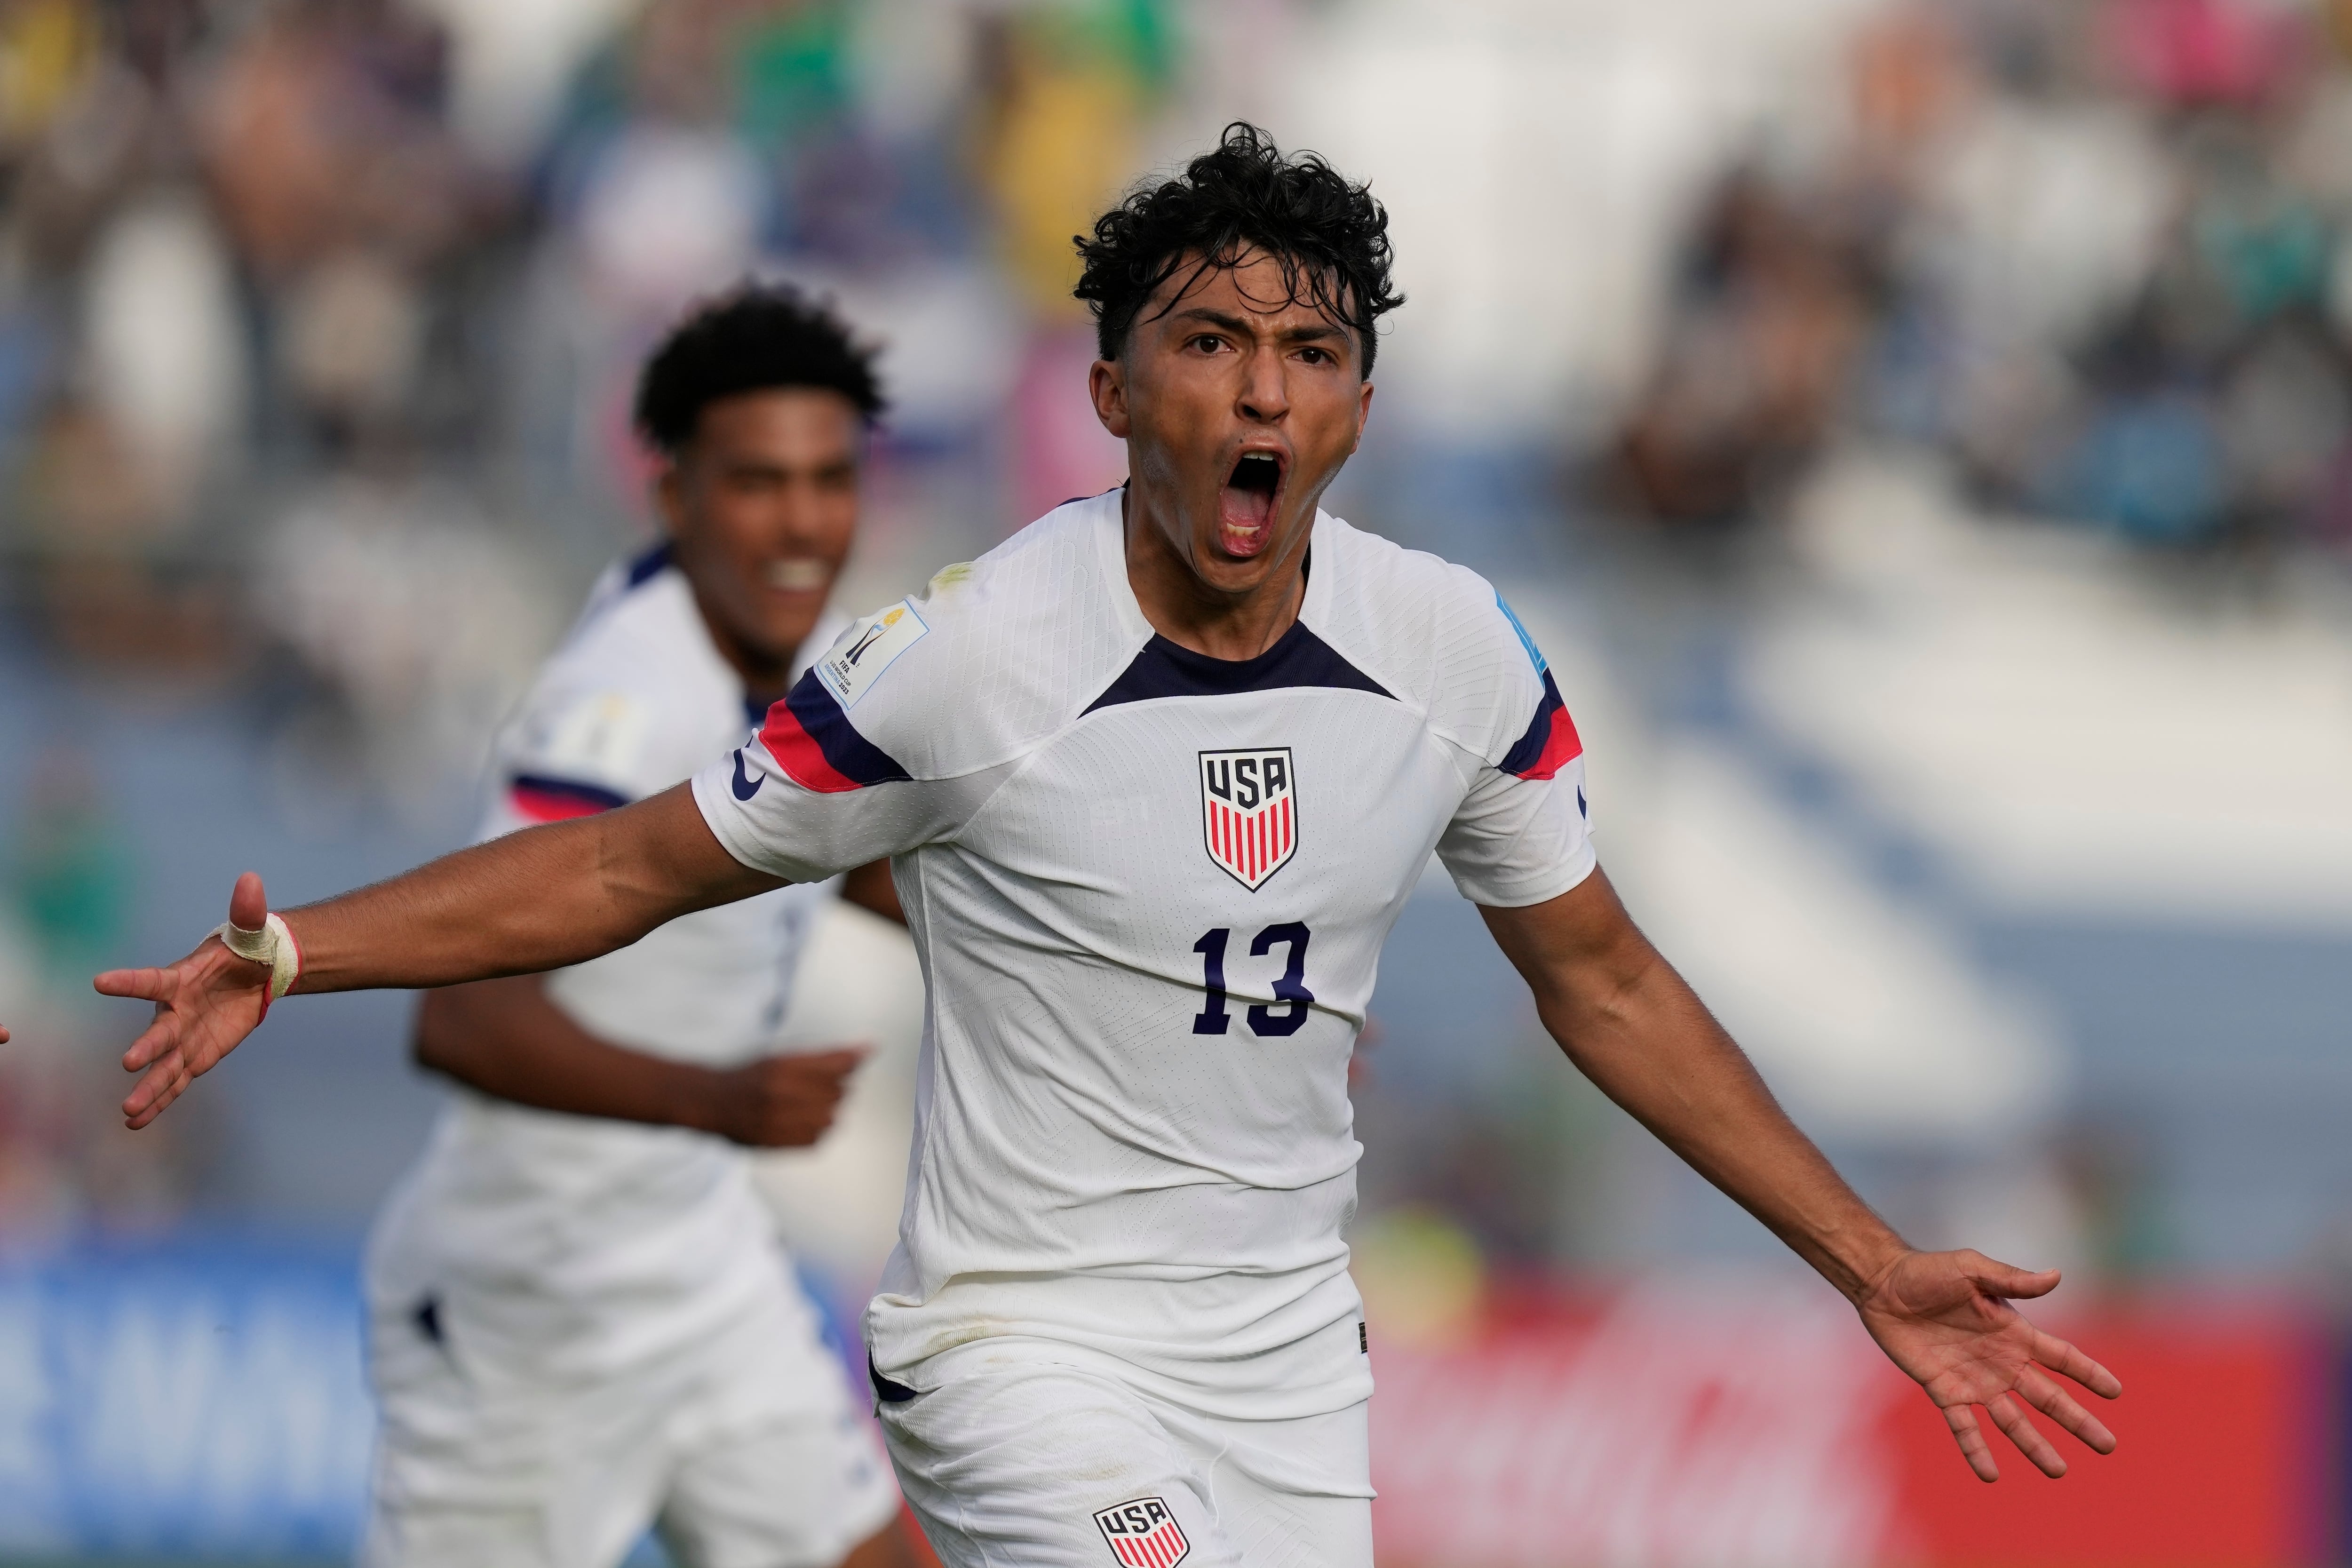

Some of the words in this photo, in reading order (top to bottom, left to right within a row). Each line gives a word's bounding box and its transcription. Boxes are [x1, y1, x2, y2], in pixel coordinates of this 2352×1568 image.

[824, 664, 840, 685] ARGENTINA
[839, 683, 849, 694] 2023
[834, 666, 845, 680] WORLD
[839, 660, 850, 674] FIFA
[1207, 757, 1287, 810] USA
[1192, 921, 1315, 1036] 13
[1102, 1502, 1167, 1533] USA
